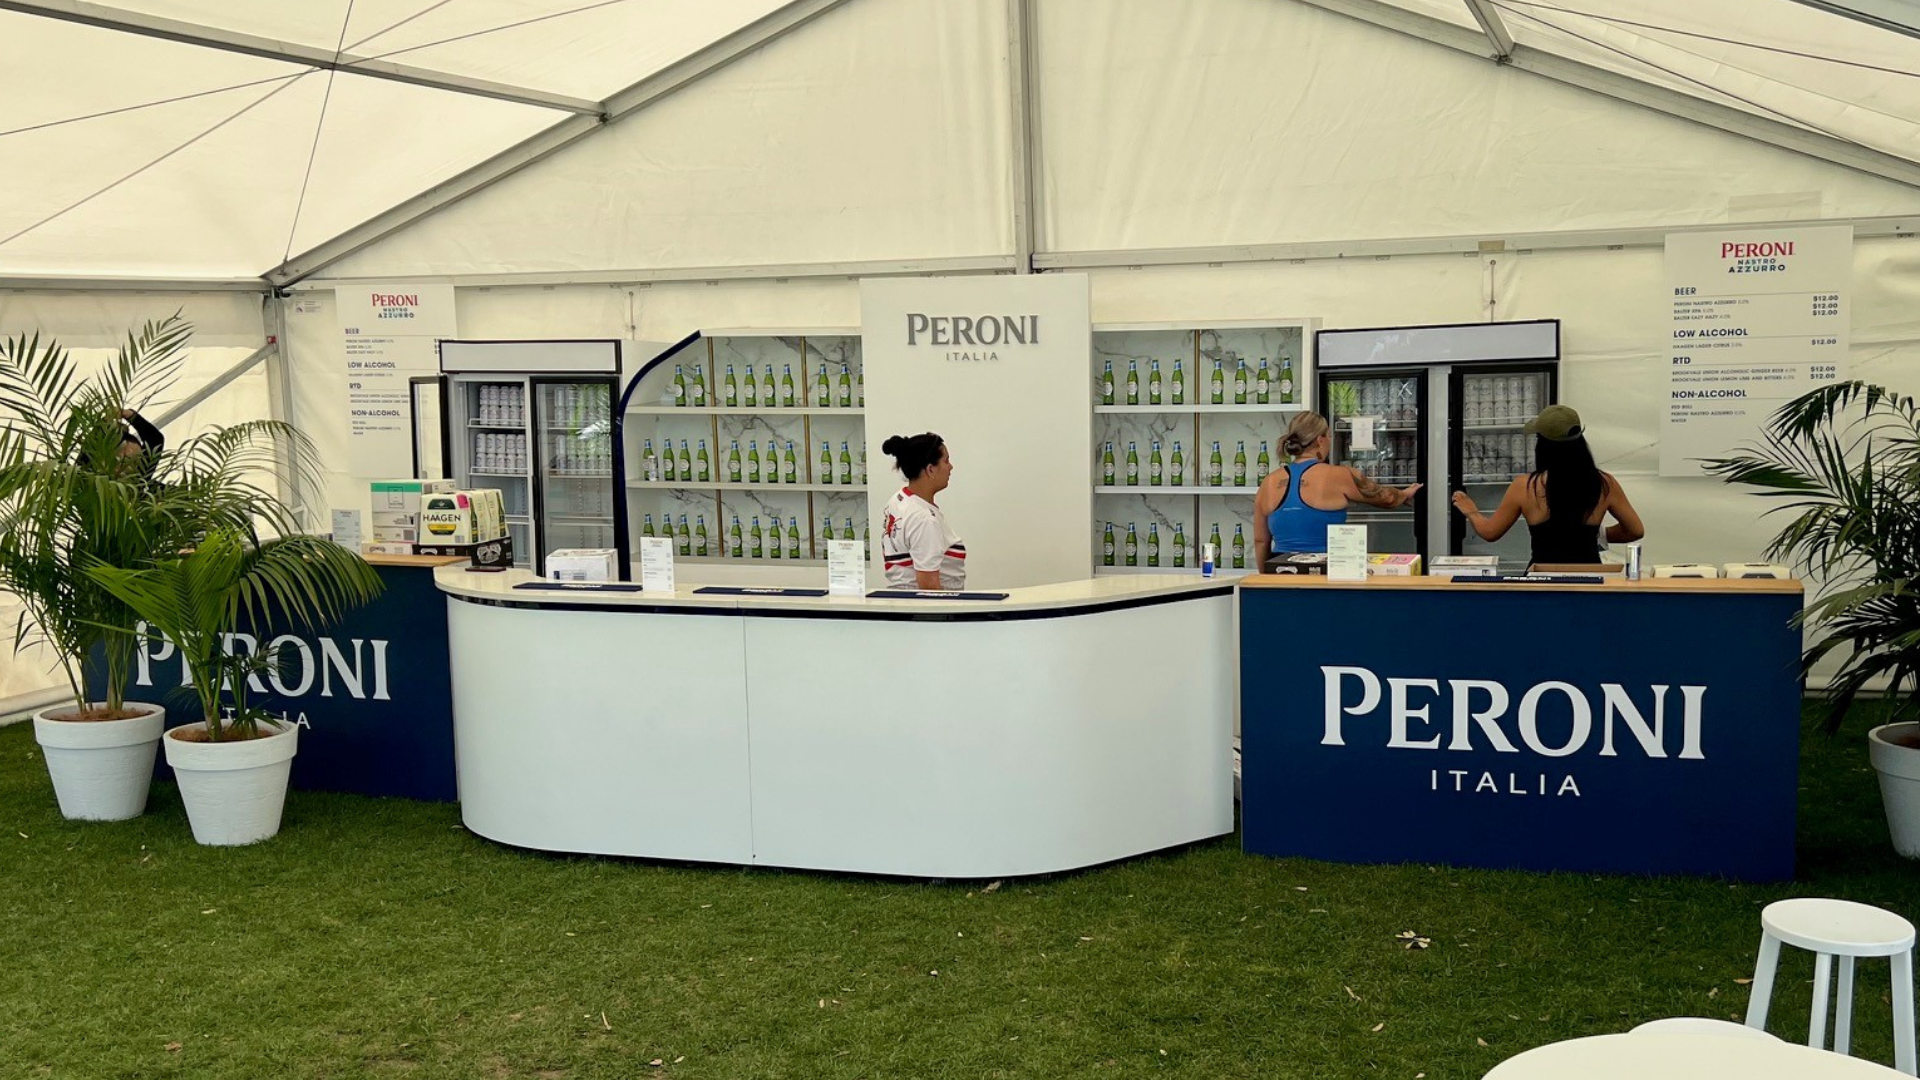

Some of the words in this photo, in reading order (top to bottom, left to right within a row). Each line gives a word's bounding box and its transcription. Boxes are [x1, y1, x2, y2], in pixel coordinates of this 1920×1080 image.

[1721, 241, 1794, 259] PERONI
[1728, 264, 1786, 273] AZZURRO
[1674, 287, 1697, 296] BEER
[371, 293, 419, 307] PERONI
[906, 313, 1039, 346] PERONI
[1673, 329, 1696, 338] LOW
[1698, 328, 1749, 337] ALCOHOL
[946, 352, 999, 361] ITALIA
[1672, 356, 1691, 365] RTD
[1671, 389, 1747, 399] NON-ALCOHOL
[351, 409, 401, 417] NON-ALCOHOL
[422, 513, 462, 522] HAAGEN
[1319, 665, 1708, 760] PERONI
[1430, 769, 1581, 797] ITALIA
